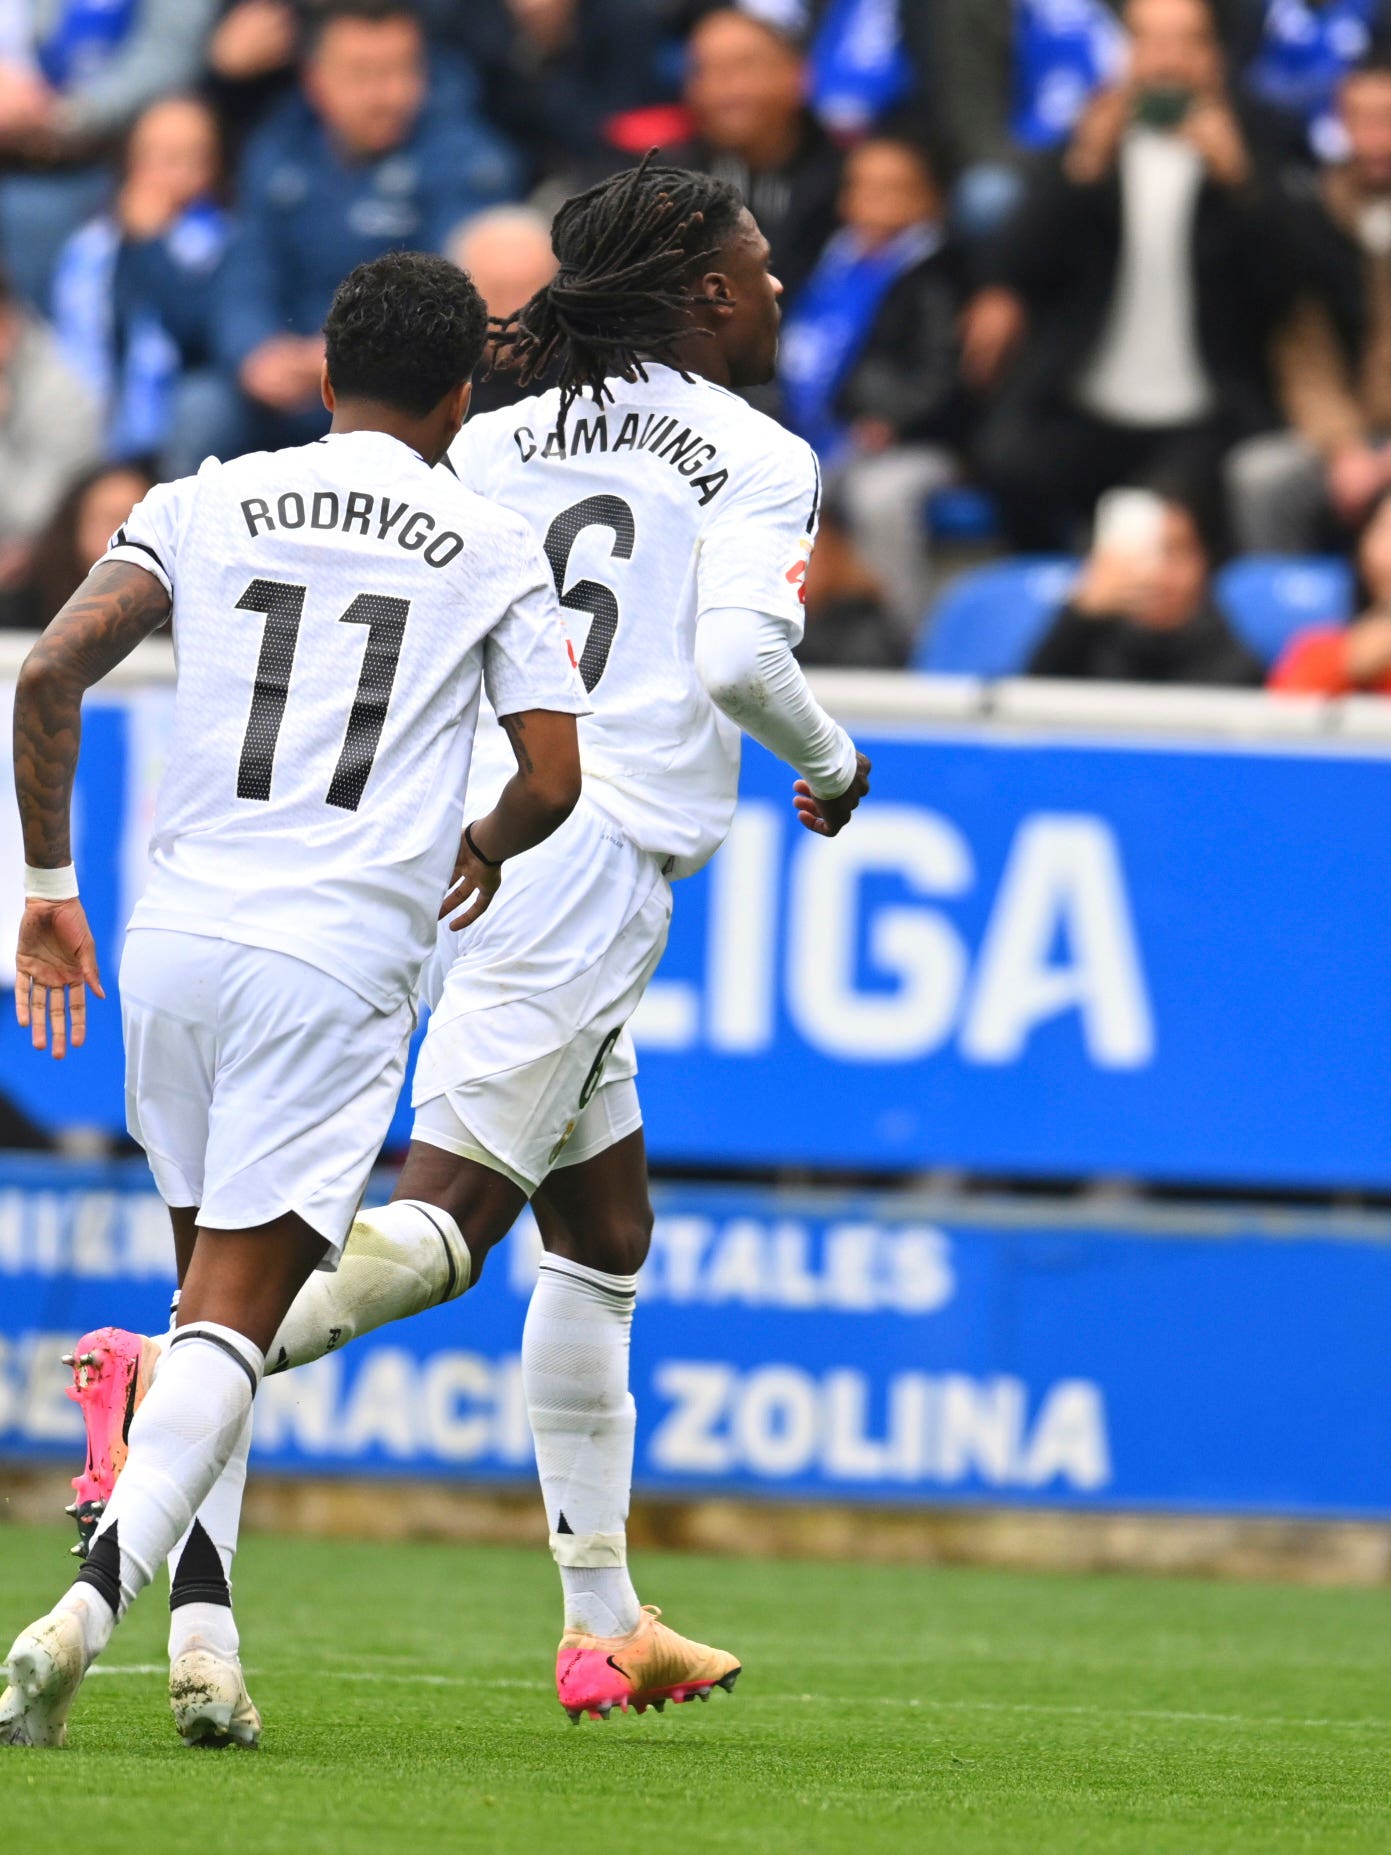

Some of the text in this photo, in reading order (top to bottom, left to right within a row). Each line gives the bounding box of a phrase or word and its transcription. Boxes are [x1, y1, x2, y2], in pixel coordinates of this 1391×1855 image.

[513, 413, 729, 507] CAMAVINGA
[240, 491, 465, 568] RODRYGO
[543, 494, 635, 694] 6
[234, 578, 411, 812] 11
[650, 1360, 1113, 1488] ZOLINA
